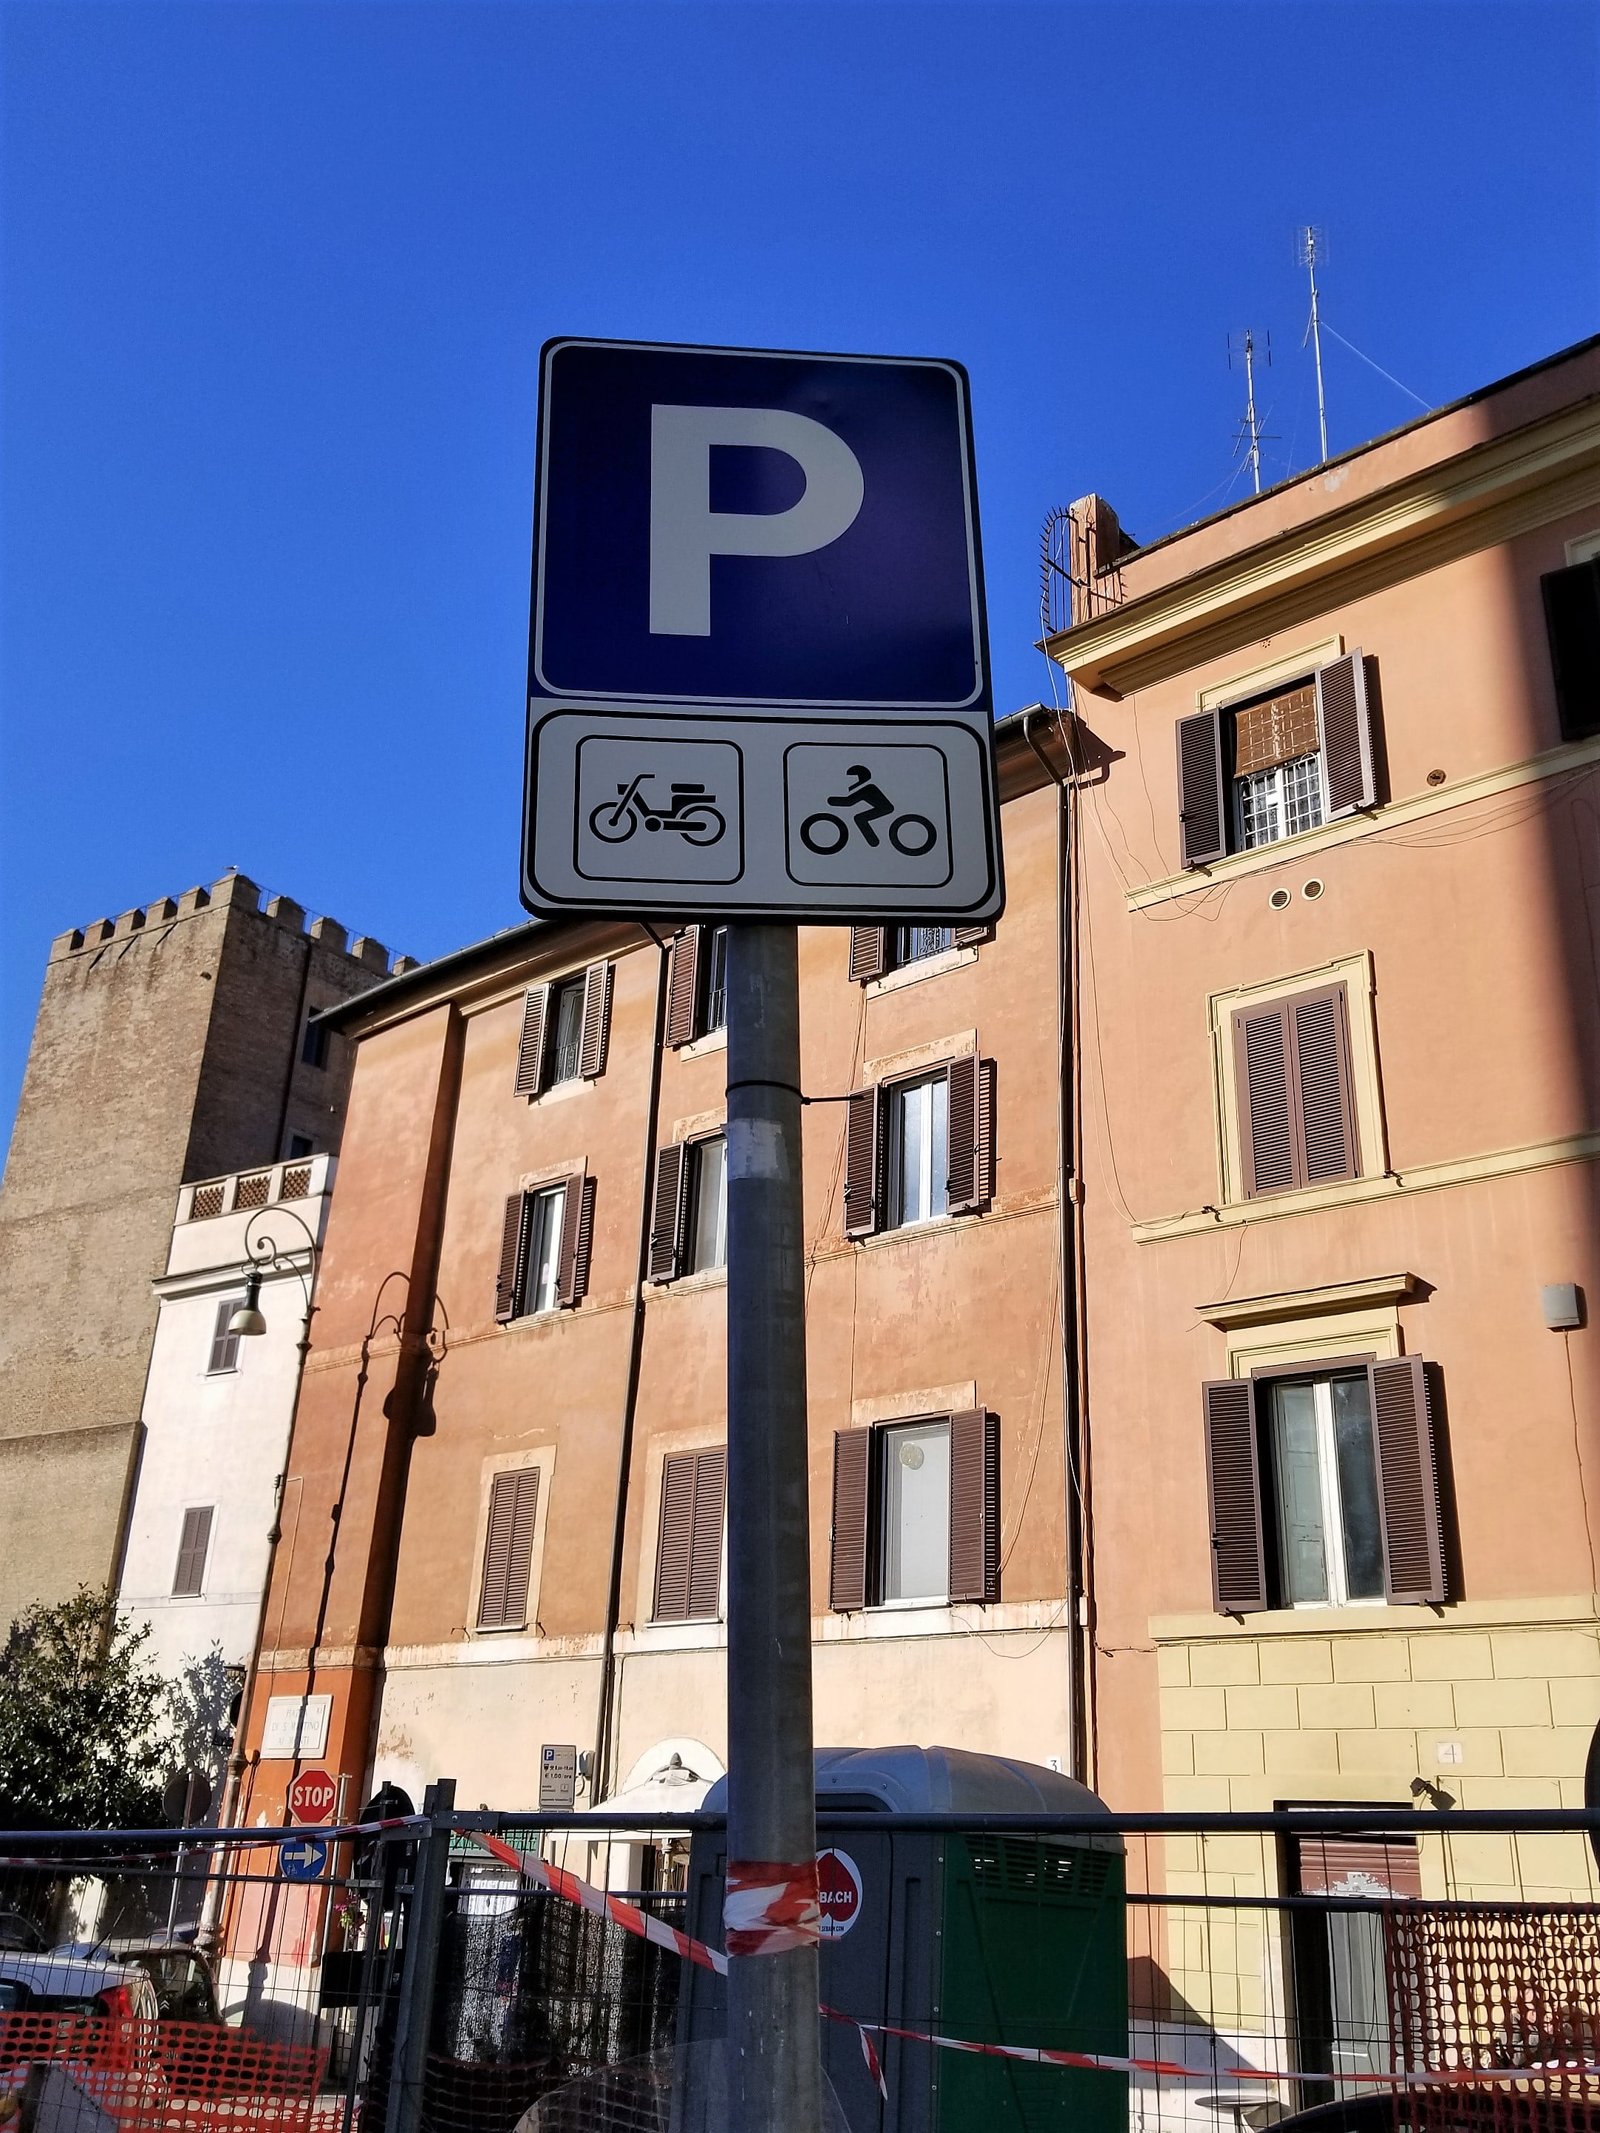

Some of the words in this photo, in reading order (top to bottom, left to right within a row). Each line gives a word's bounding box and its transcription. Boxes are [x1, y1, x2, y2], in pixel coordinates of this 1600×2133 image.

[649, 403, 865, 637] P
[546, 1750, 553, 1760] P
[294, 1786, 334, 1807] STOP
